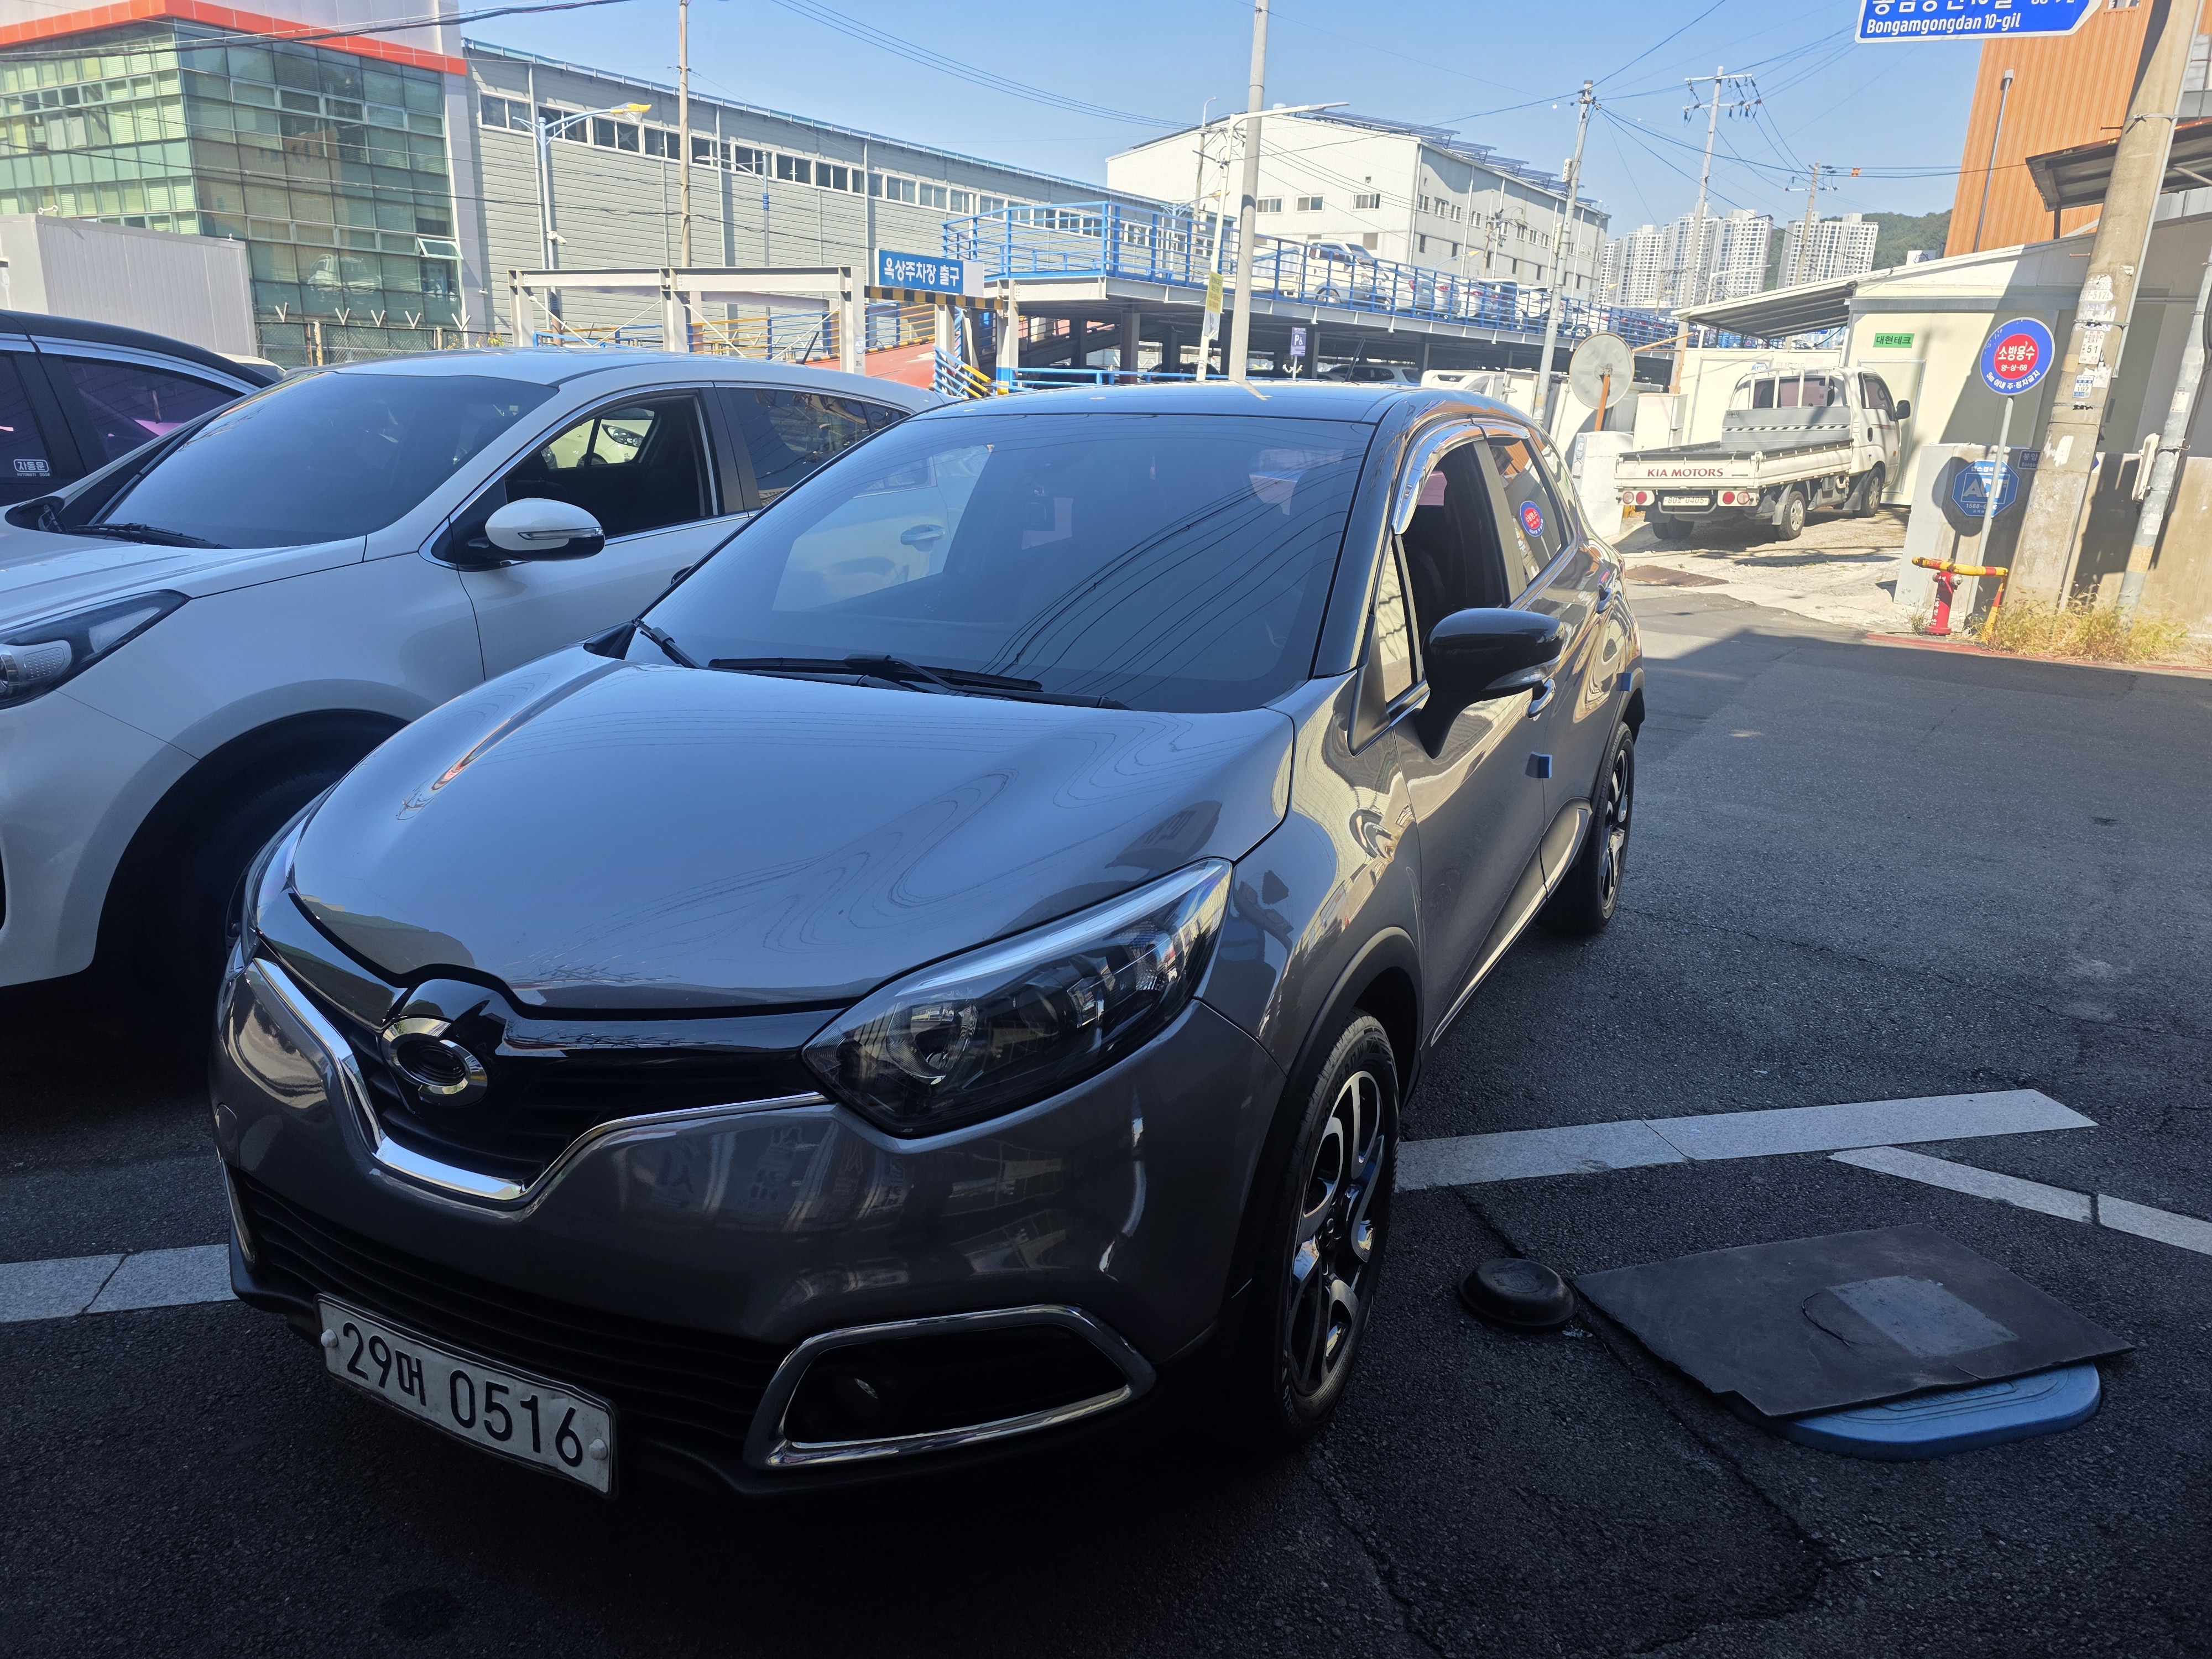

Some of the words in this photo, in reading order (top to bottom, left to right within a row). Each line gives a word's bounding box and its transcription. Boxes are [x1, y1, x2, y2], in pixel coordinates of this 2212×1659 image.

[1866, 14, 1981, 35] Bongamgongdan
[1984, 13, 2020, 31] 10-gil
[884, 257, 937, 285] 옥상주차장
[940, 265, 959, 286] 출구
[1876, 336, 1911, 345] 대현테크
[1997, 345, 2036, 361] 소방용수
[2087, 345, 2098, 353] 51
[1994, 379, 2006, 389] 이내
[17, 461, 45, 471] 자동문
[1671, 468, 1724, 477] MOTORS
[342, 1321, 427, 1406] 29머
[450, 1370, 583, 1467] 0516
